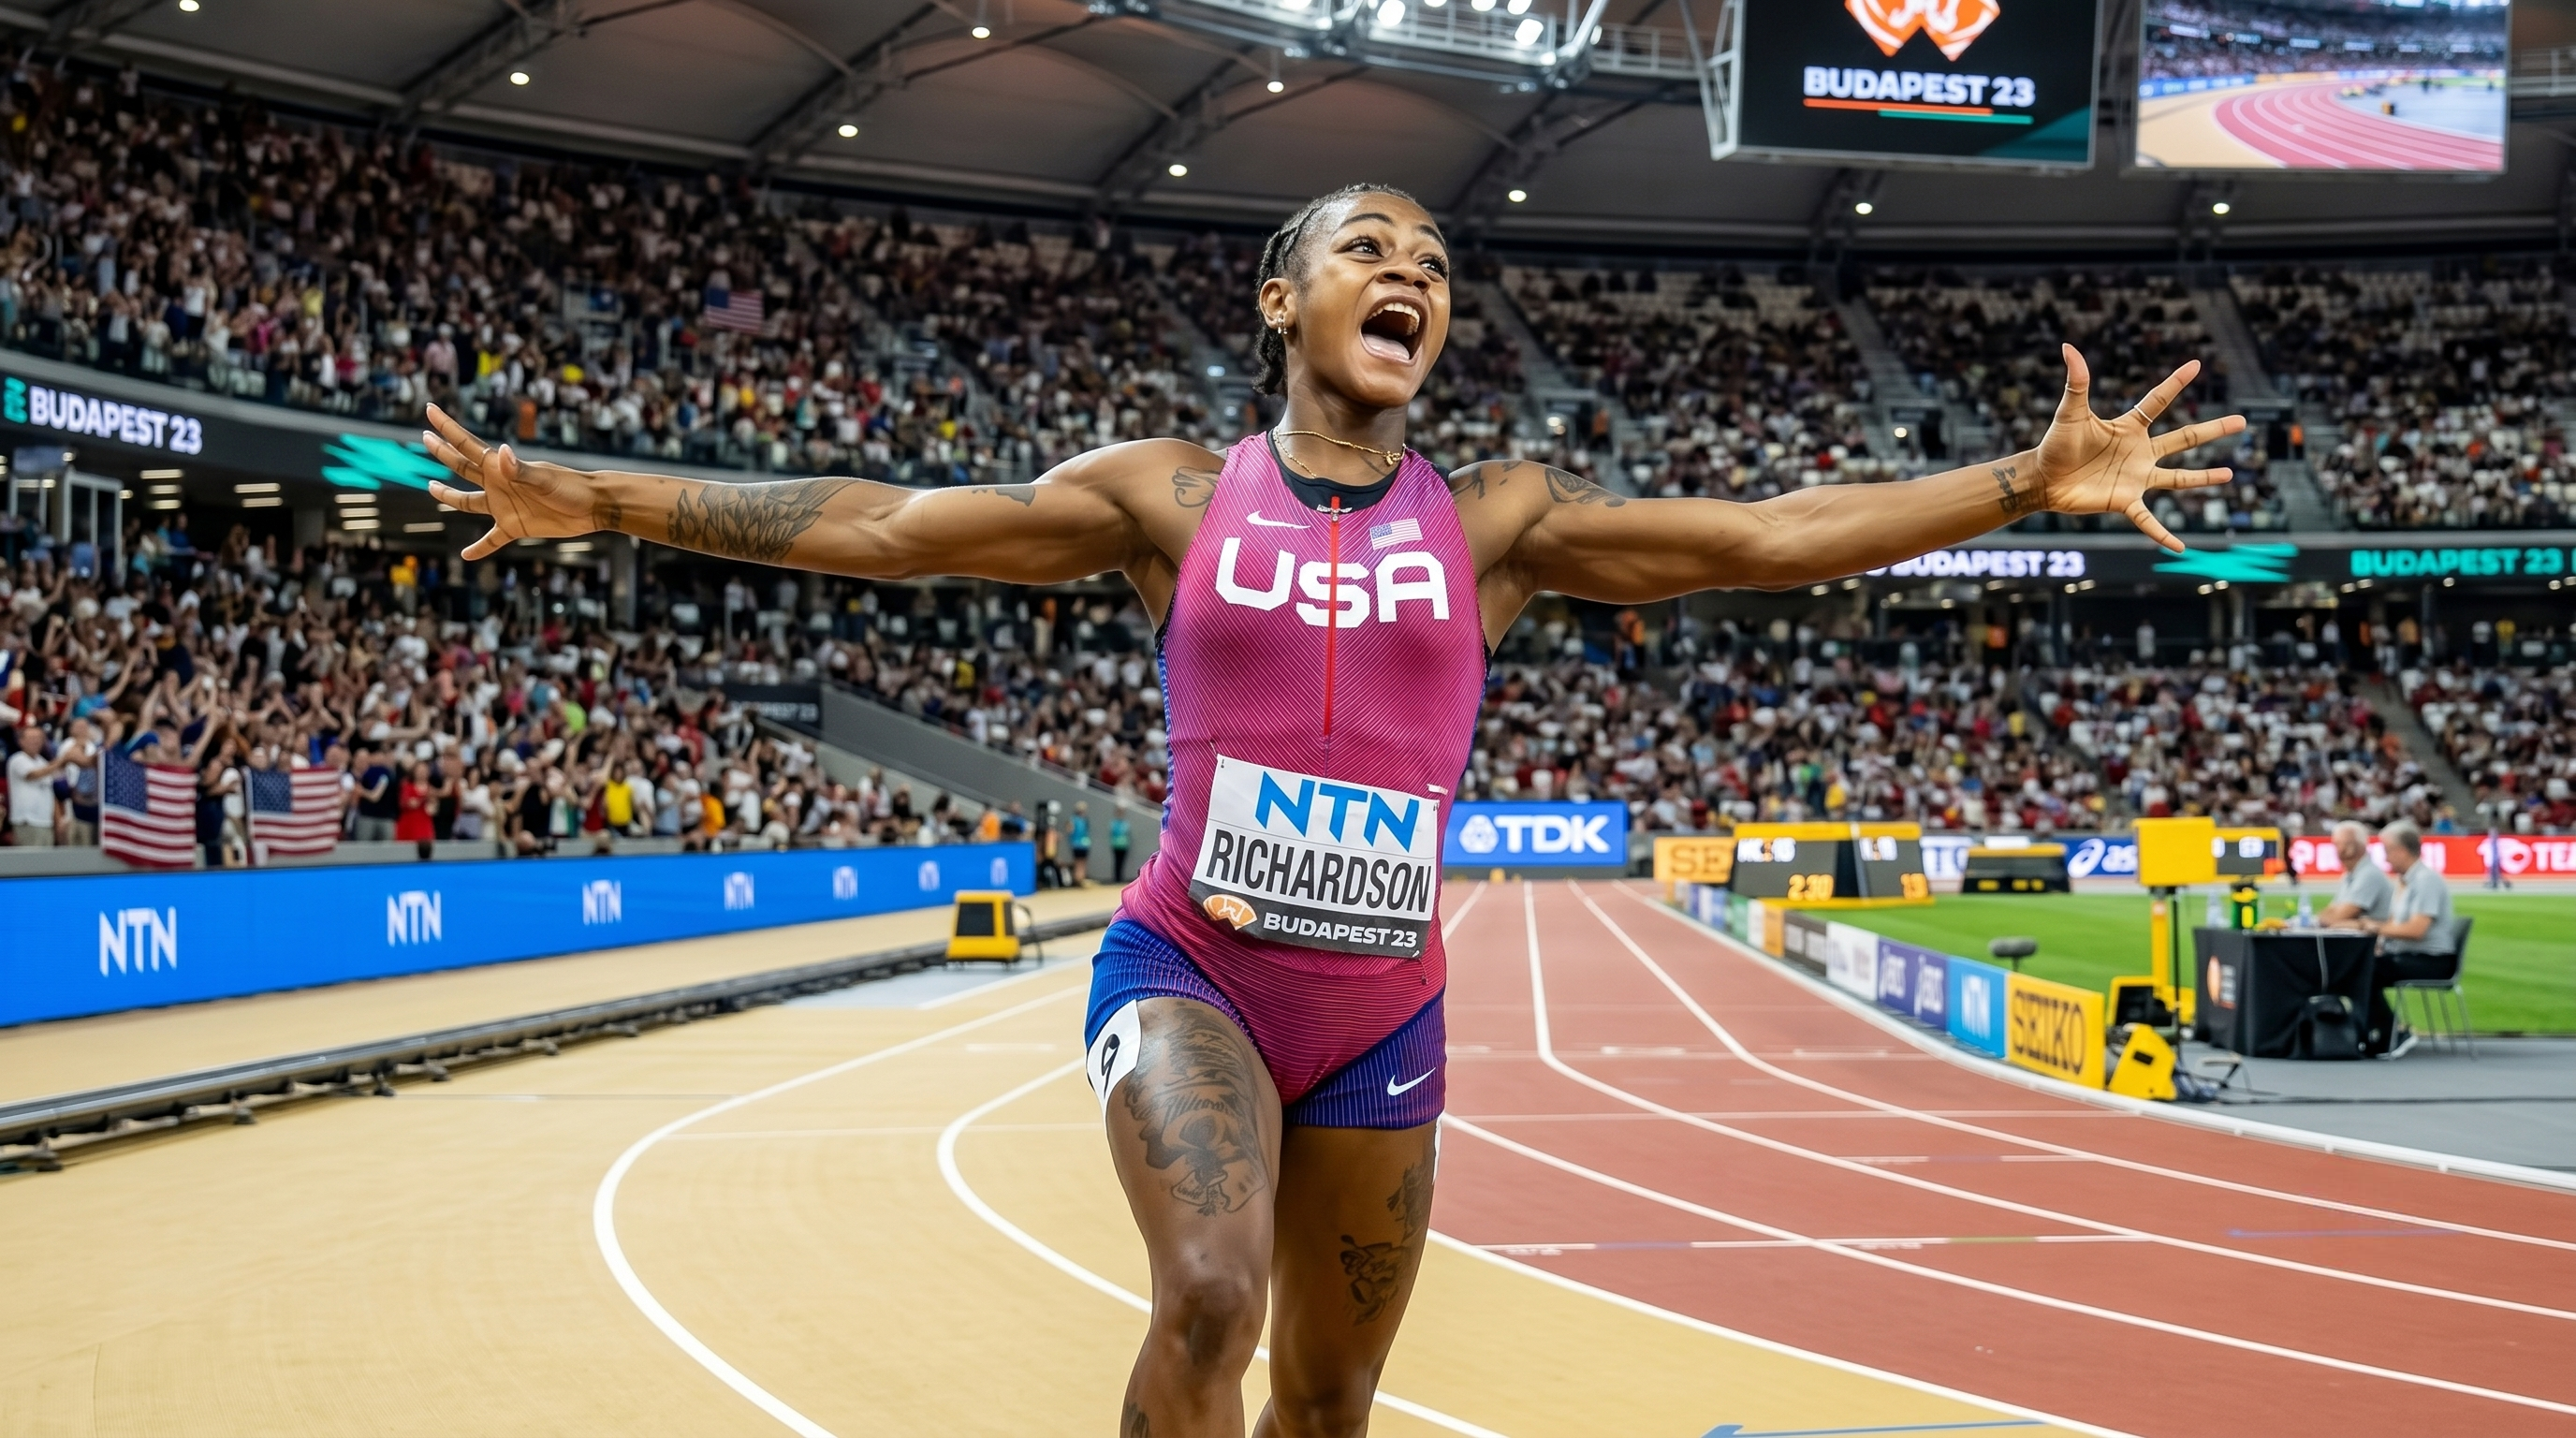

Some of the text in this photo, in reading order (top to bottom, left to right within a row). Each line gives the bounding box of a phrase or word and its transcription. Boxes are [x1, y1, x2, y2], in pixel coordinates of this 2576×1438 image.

[1804, 66, 2035, 107] BUDAPEST 23
[30, 386, 202, 455] BUDAPEST 23
[1216, 537, 1450, 628] USA
[2047, 550, 2086, 577] 23
[2350, 549, 2521, 577] BUDAPEST
[2524, 548, 2564, 574] 23
[1255, 770, 1419, 853] NTN
[1500, 814, 1611, 854] TDK
[1206, 829, 1432, 913] RICHARDSON
[387, 890, 442, 946] NTN
[582, 879, 622, 925] NTN
[1264, 912, 1417, 947] BUDAPEST 23
[98, 905, 177, 976] NTN
[2013, 988, 2086, 1075] SEIKO
[1102, 1033, 1120, 1098] 9
